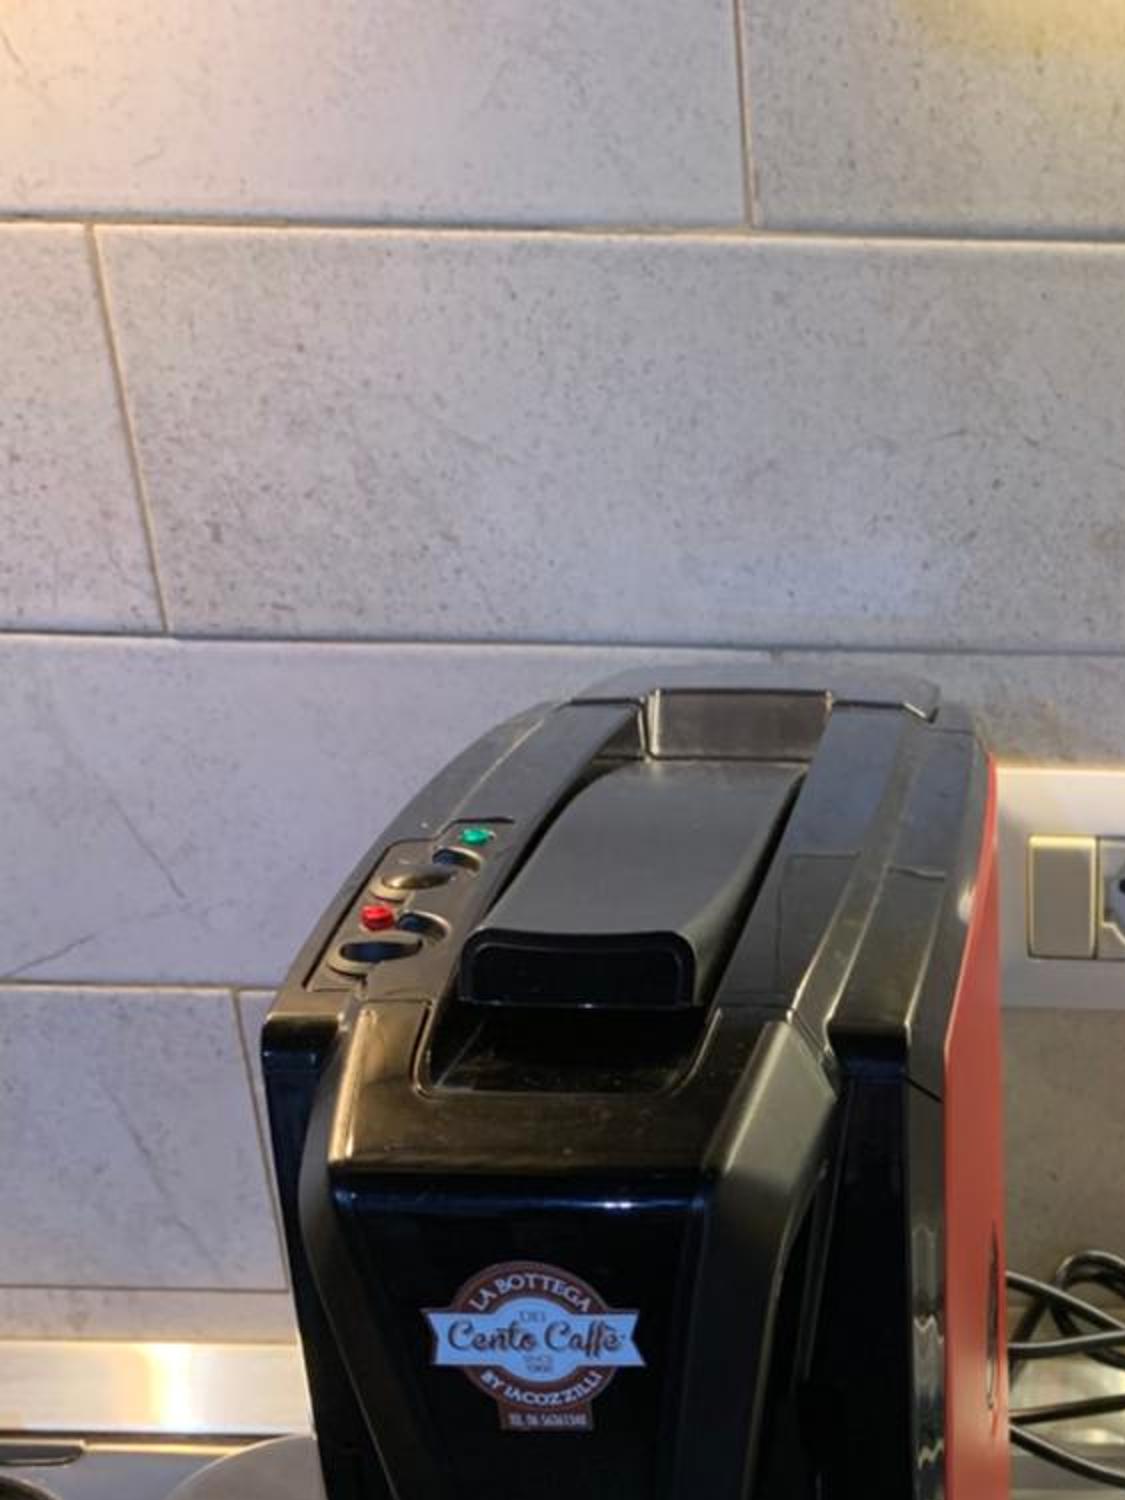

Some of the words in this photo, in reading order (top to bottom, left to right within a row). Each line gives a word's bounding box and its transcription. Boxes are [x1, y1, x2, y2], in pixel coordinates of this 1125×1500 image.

[469, 1288, 497, 1311] LA
[495, 1274, 591, 1312] BOTTEGA
[447, 1319, 537, 1351] Cento
[544, 1318, 620, 1358] Caffè
[481, 1369, 504, 1389] BY
